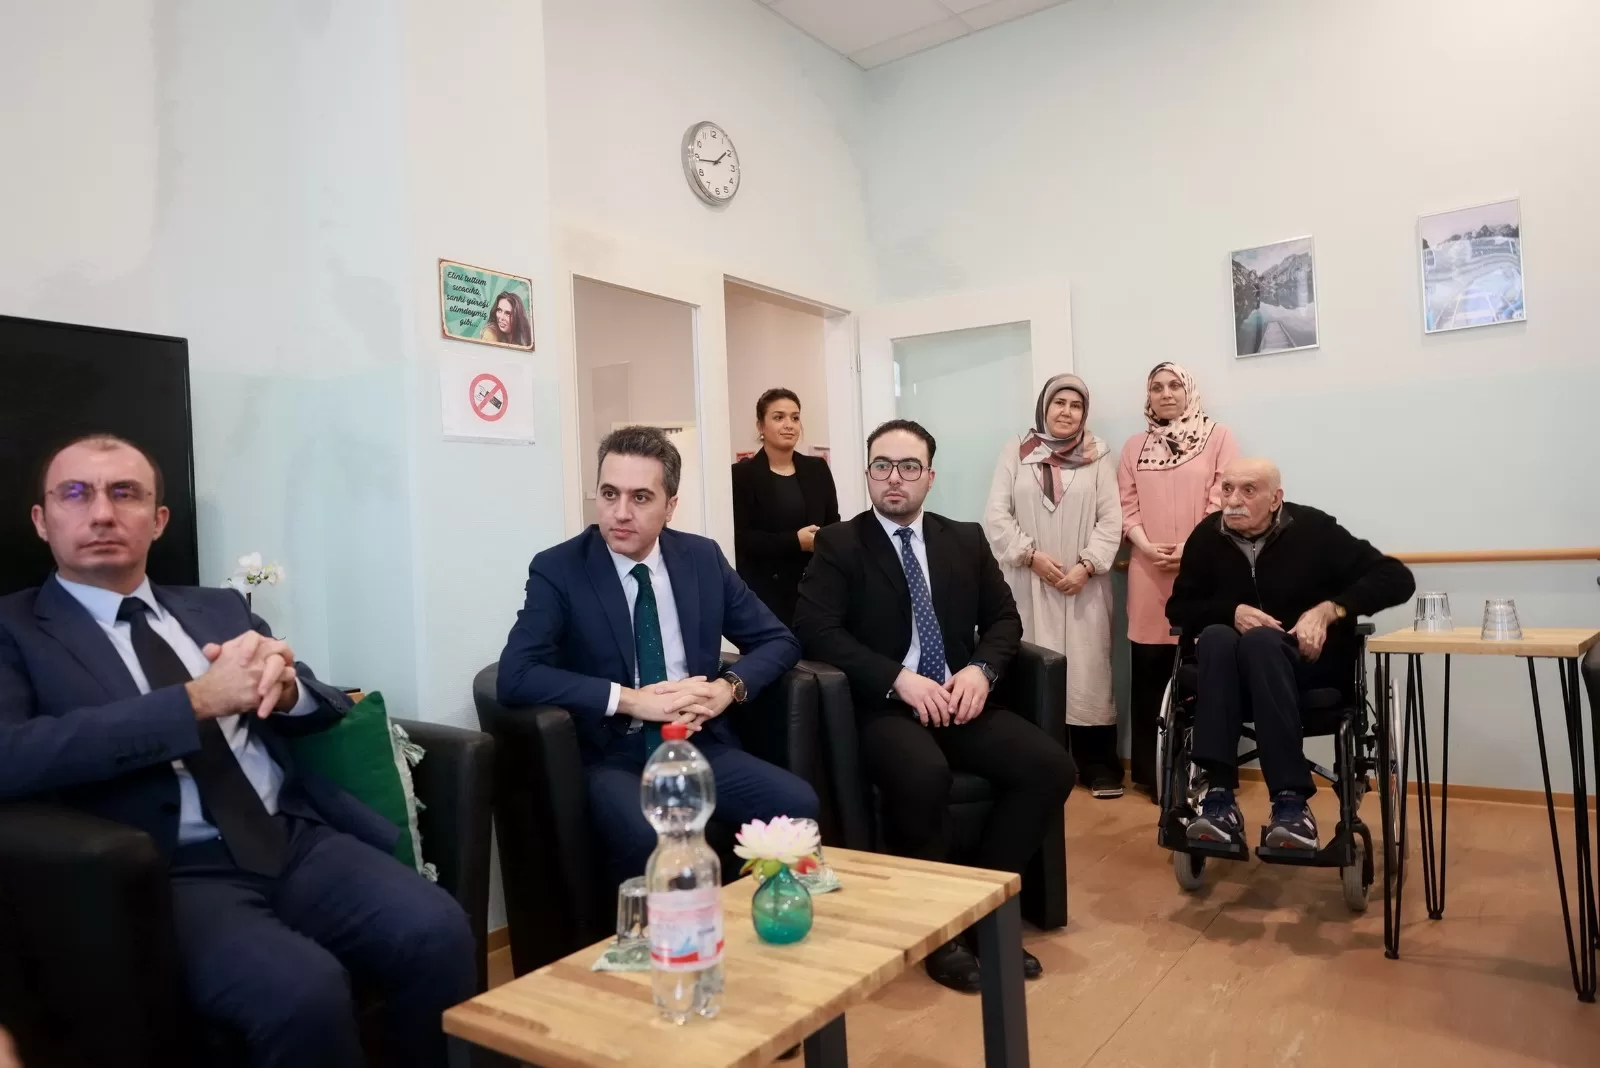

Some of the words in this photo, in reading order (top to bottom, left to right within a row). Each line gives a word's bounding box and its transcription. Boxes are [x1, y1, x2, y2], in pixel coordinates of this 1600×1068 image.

[447, 271, 463, 281] Elini
[464, 275, 487, 286] tuttum
[446, 294, 466, 304] sanki
[449, 305, 488, 320] elimdeymiş
